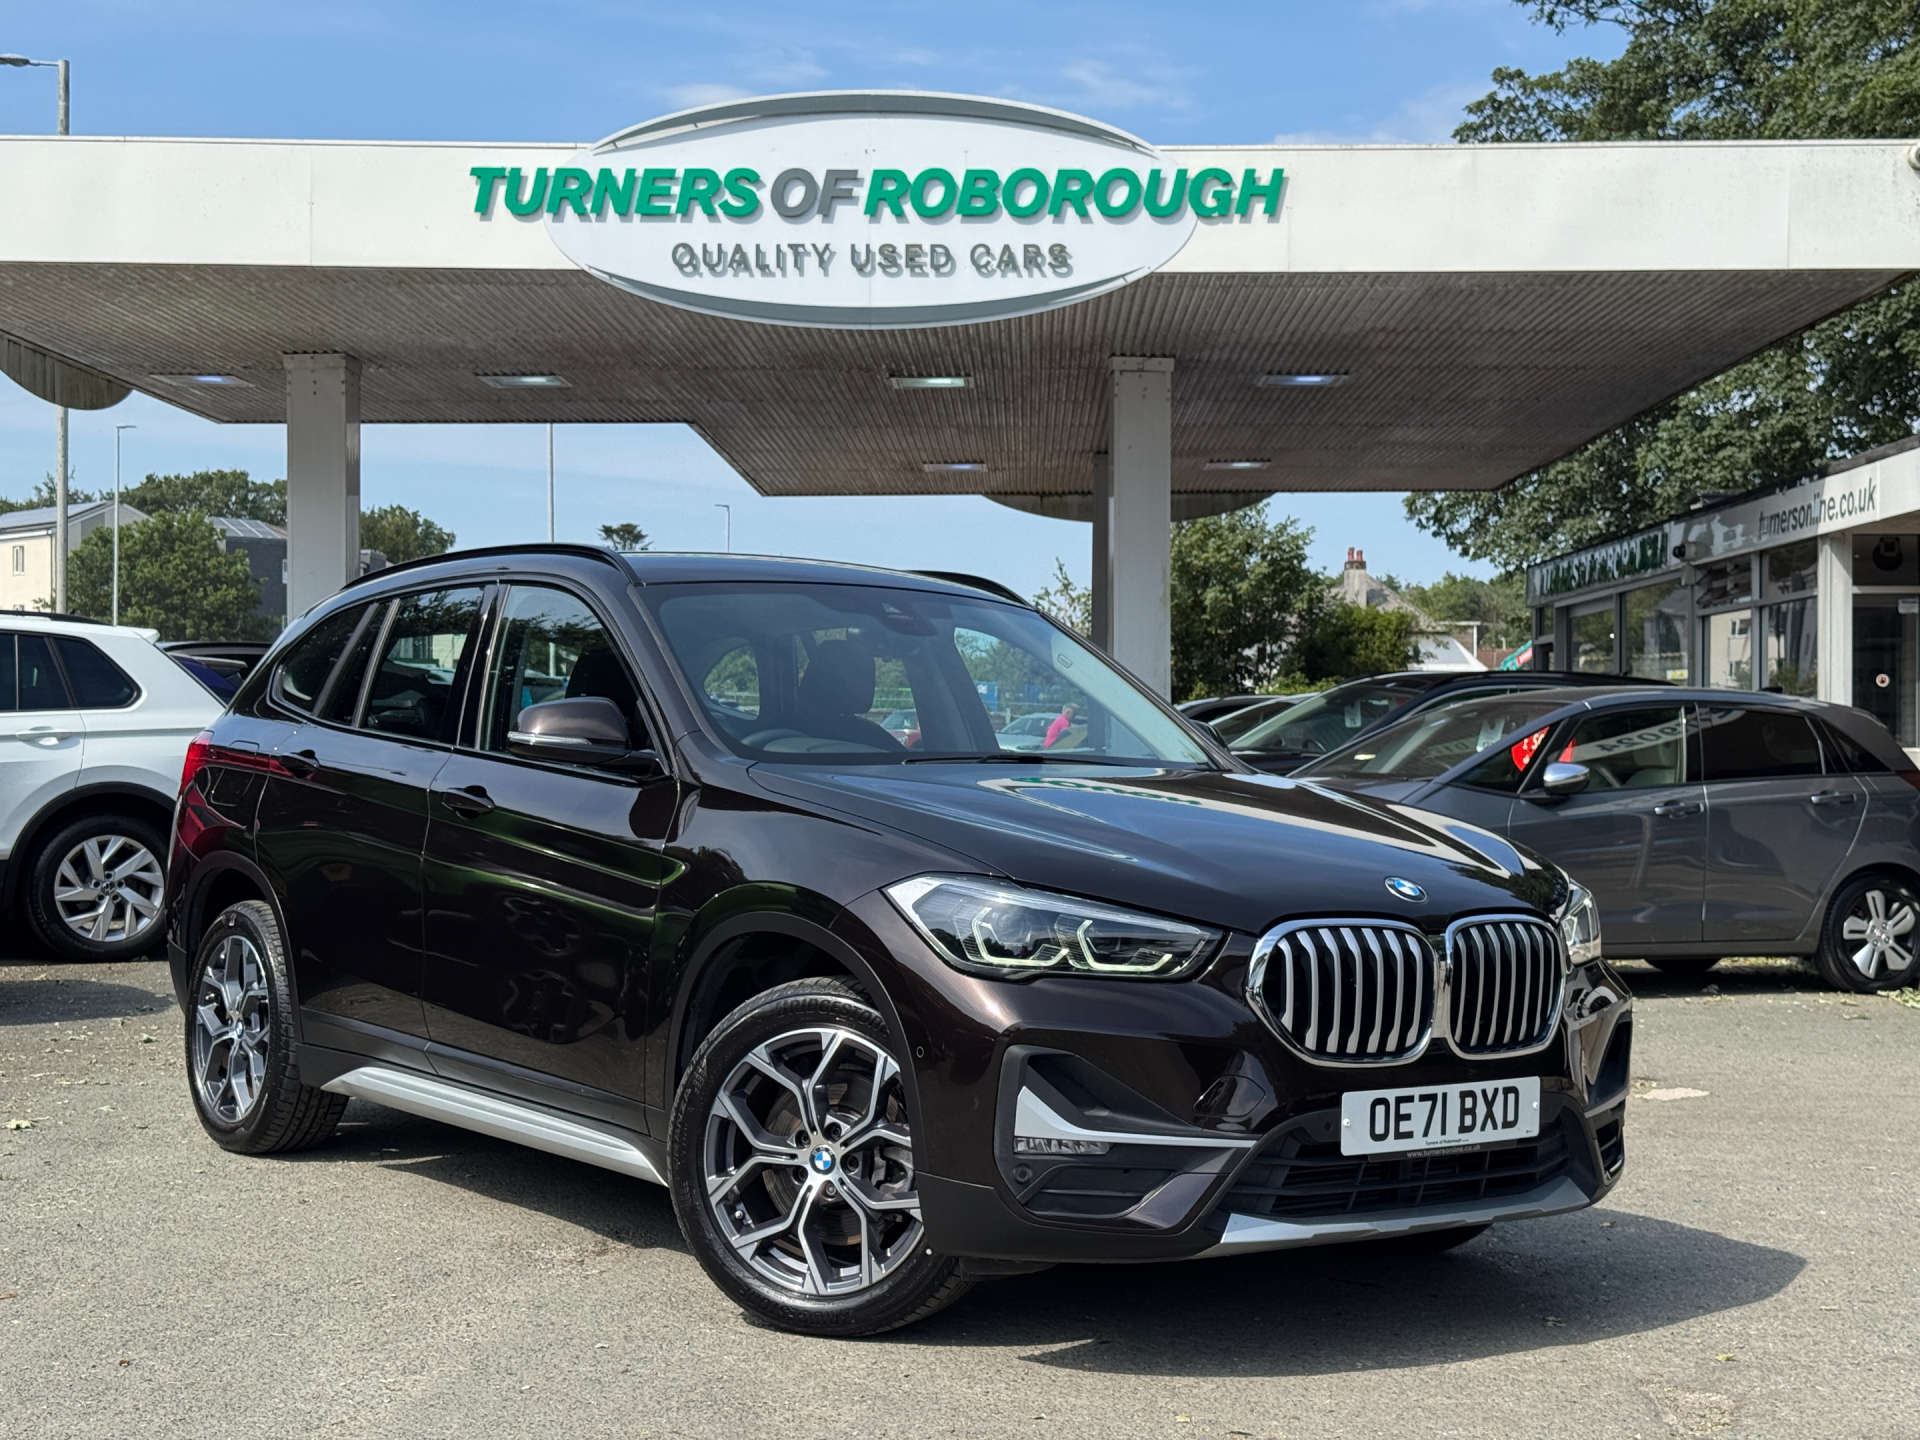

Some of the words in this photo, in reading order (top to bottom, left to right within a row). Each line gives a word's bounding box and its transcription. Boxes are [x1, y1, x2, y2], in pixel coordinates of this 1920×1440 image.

[470, 167, 762, 217] TURNERS
[770, 168, 860, 218] OF
[863, 167, 1284, 218] ROBOROUGH
[671, 242, 834, 274] QUALITY
[850, 242, 953, 274] USED
[969, 242, 1070, 274] CARS
[1369, 1091, 1448, 1142] OE71
[1458, 1085, 1520, 1134] BXD
